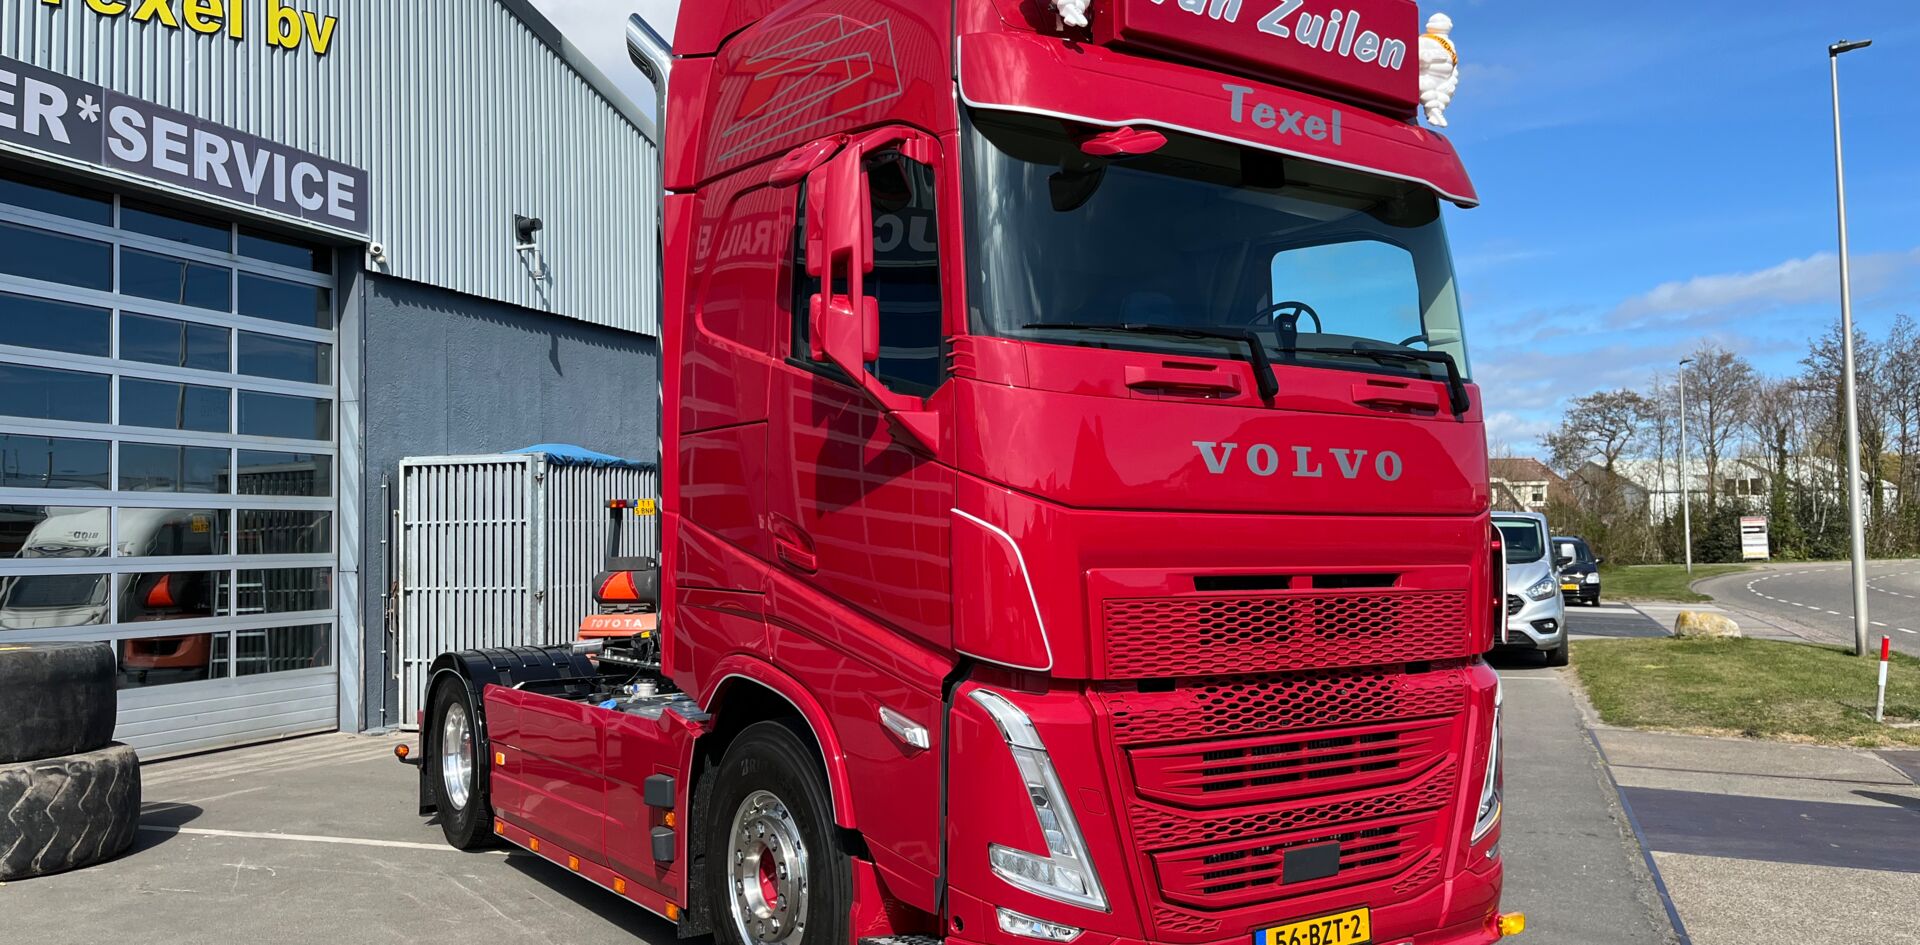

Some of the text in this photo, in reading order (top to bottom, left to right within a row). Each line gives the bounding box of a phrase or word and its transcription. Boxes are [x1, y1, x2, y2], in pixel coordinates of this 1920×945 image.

[41, 0, 337, 54] xel bv
[1256, 0, 1406, 70] Zuilen
[1221, 84, 1342, 145] Texel
[1192, 441, 1403, 481] VOLVO
[591, 618, 642, 628] TOYOTA
[1276, 914, 1362, 945] 56-BZT-2
